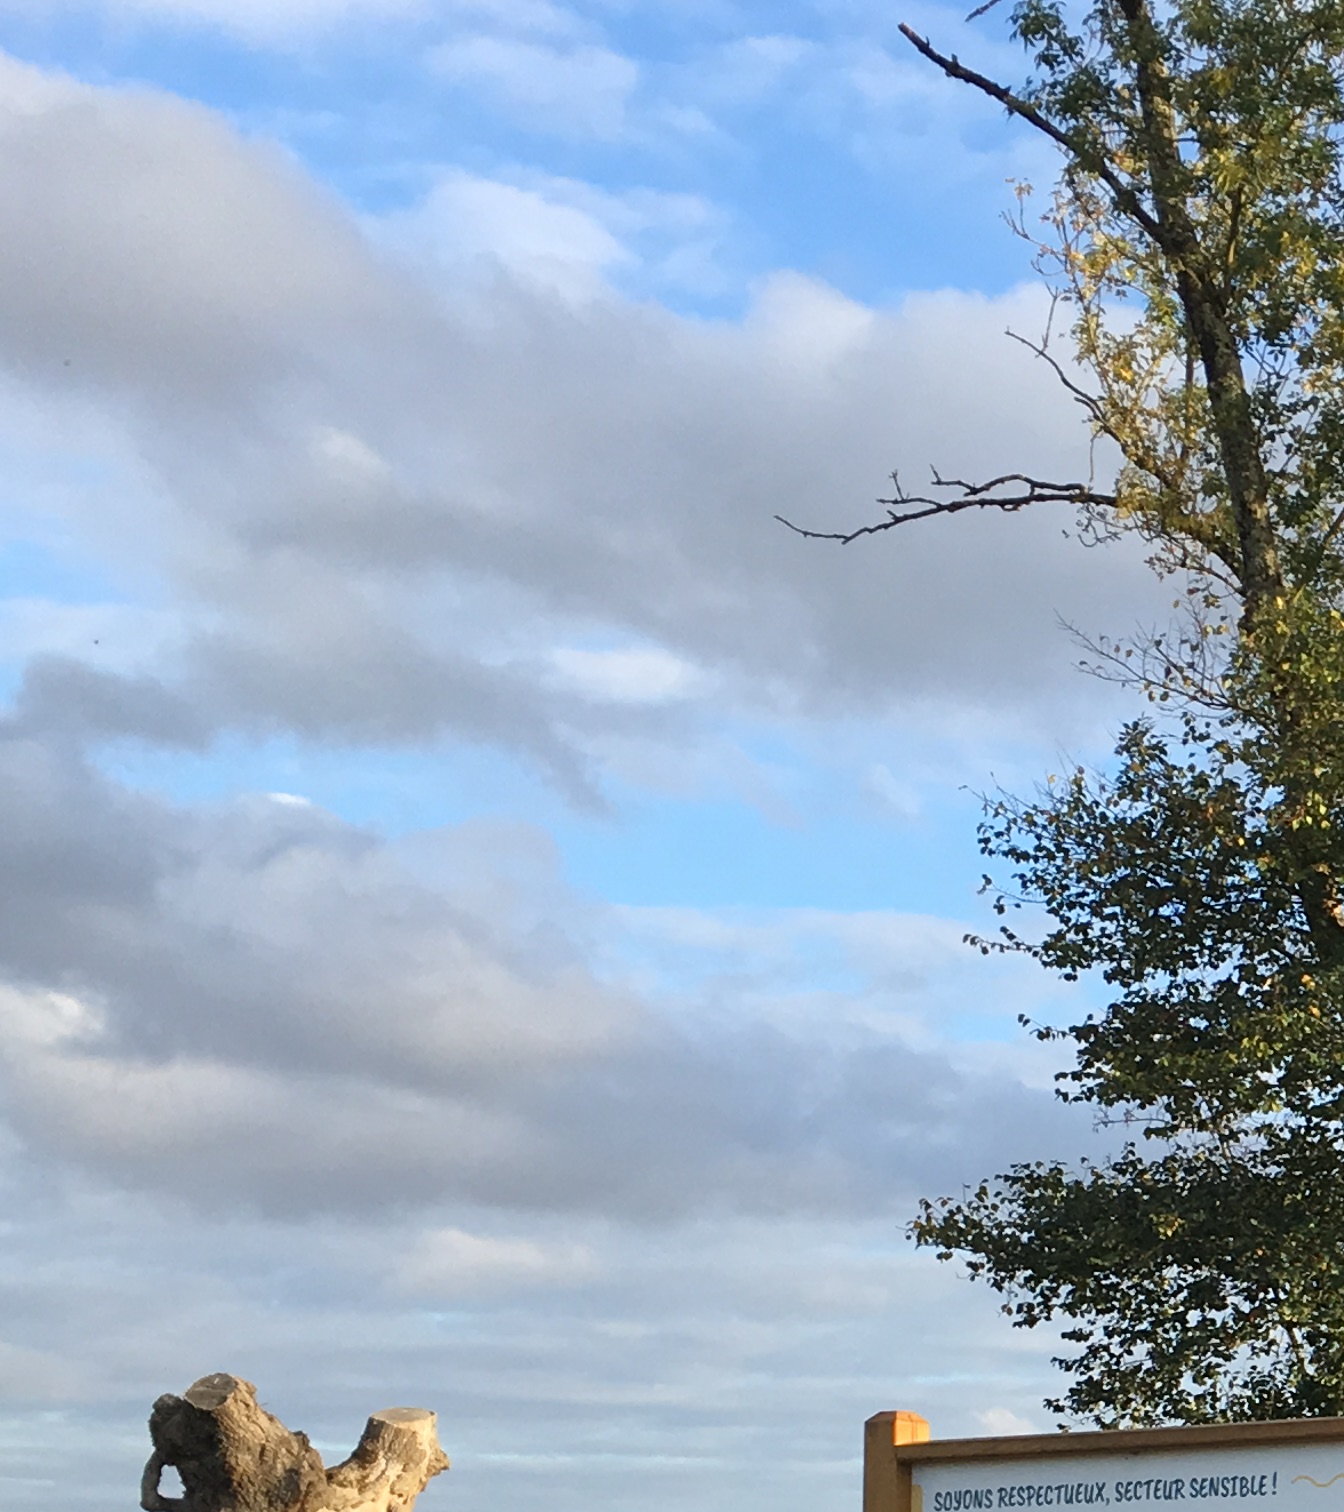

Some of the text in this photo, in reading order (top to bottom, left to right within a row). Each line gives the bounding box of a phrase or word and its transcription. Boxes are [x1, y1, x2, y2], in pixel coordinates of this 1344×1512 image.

[934, 1489, 993, 1511] SOYONS
[997, 1482, 1111, 1508] RESPECTUEUX,
[1114, 1479, 1186, 1503] SECTEUR
[1189, 1475, 1267, 1498] SENSIBLE
